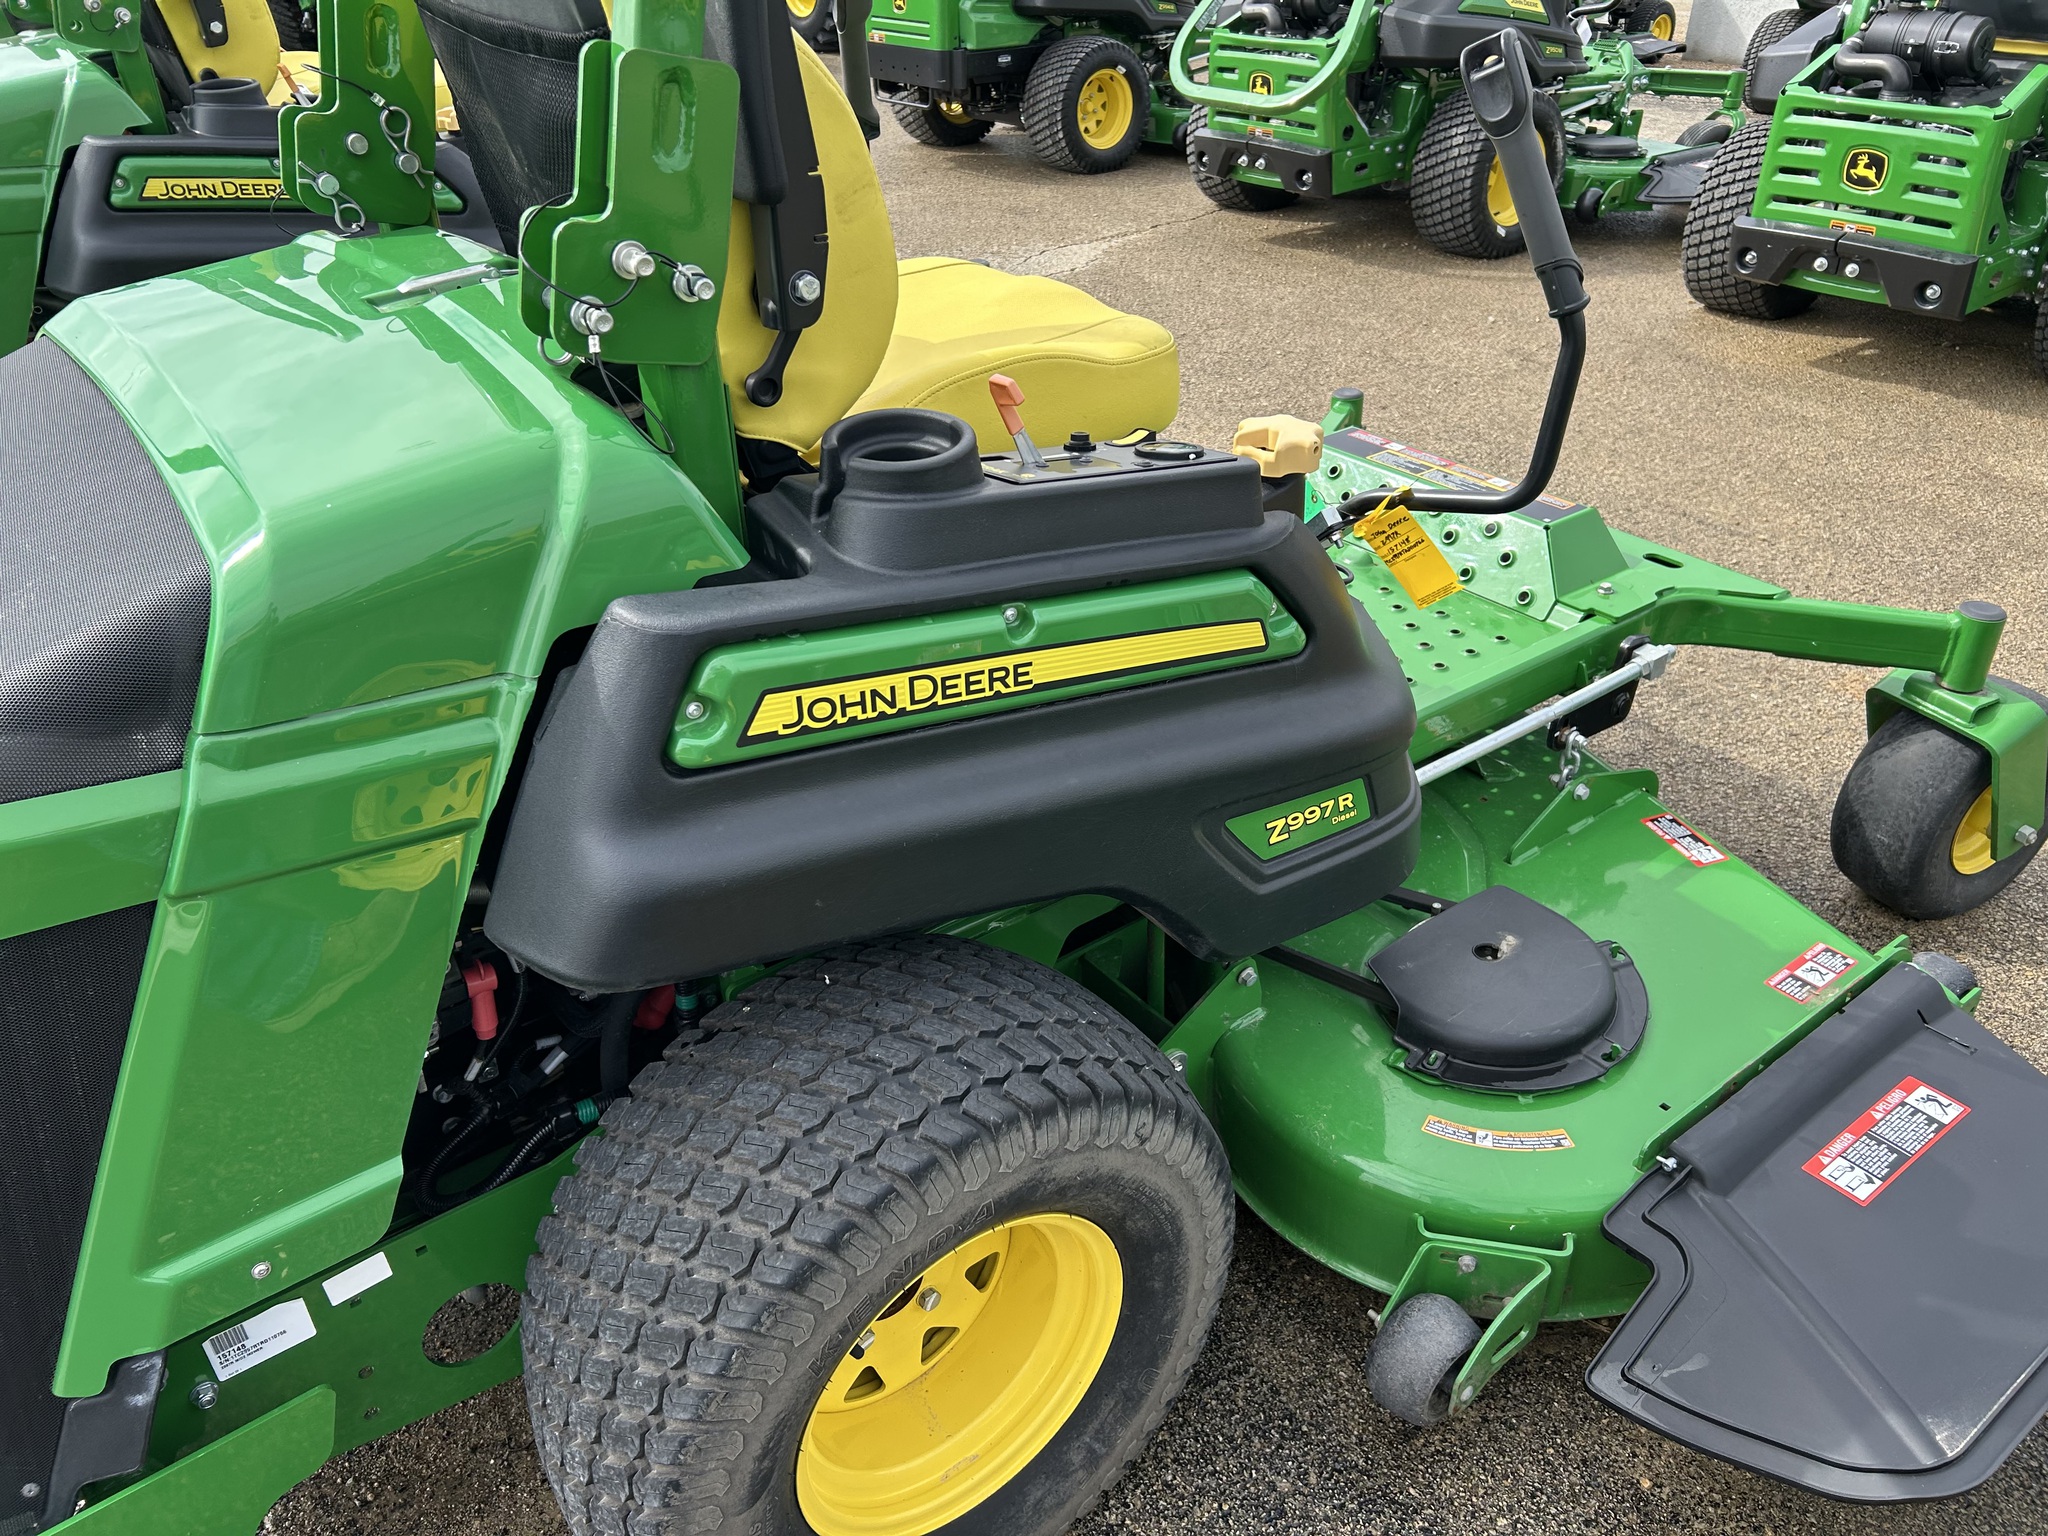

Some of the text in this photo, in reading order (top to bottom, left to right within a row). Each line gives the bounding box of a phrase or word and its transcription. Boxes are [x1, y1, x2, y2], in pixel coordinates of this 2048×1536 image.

[159, 181, 216, 197] JOHN
[782, 661, 1034, 730] JOHN DEERE
[1331, 808, 1357, 825] Diesel
[1875, 1089, 1907, 1114] PELIGRO
[1823, 1132, 1857, 1158] DANGER
[806, 1199, 995, 1378] KENDA
[216, 1343, 247, 1361] 157148
